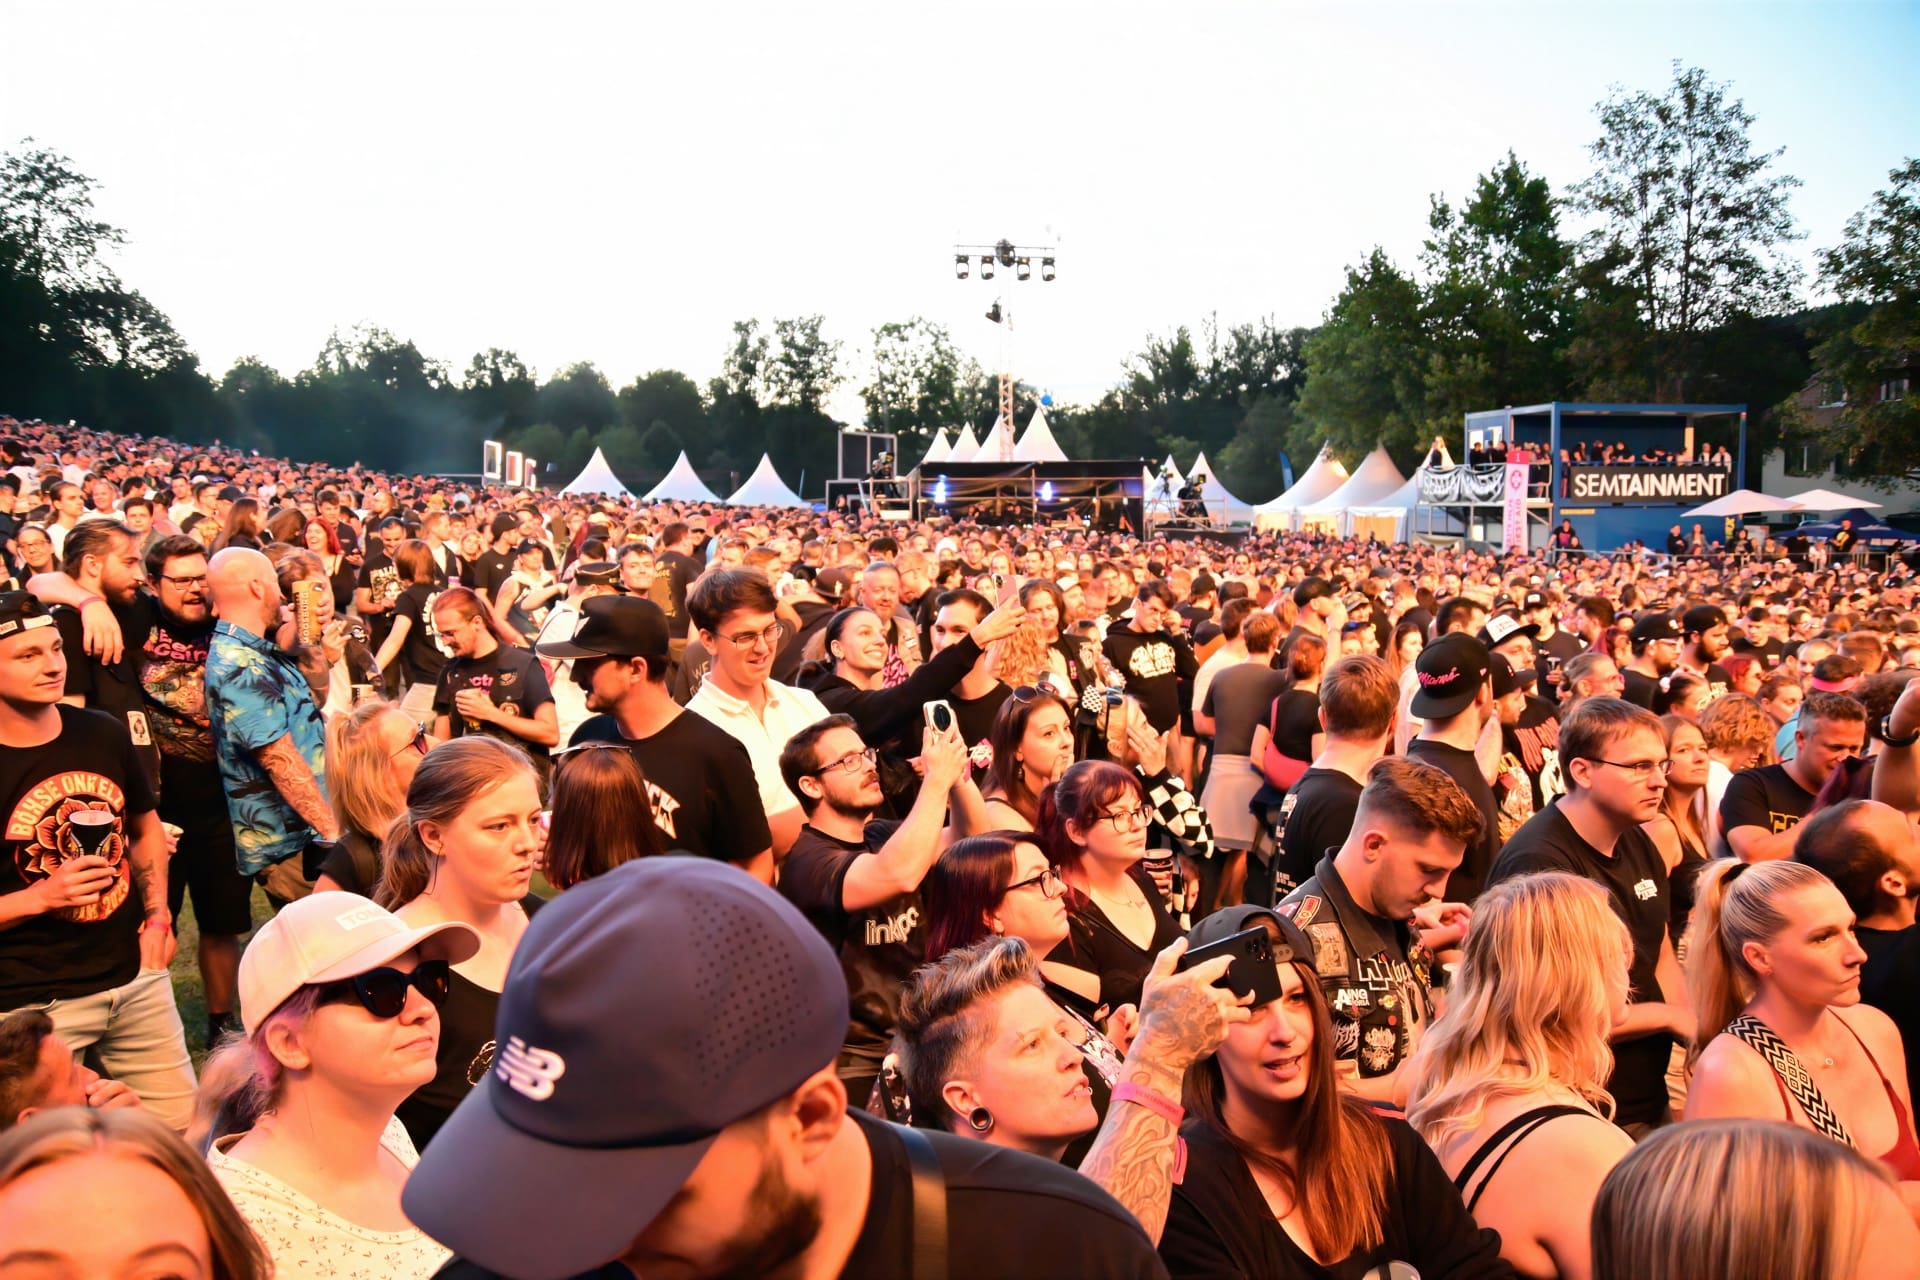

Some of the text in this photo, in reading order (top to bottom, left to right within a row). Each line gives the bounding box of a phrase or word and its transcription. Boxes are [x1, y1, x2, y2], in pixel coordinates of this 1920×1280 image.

[1574, 473, 1725, 497] SEMTAINMENT
[10, 773, 124, 836] BÖHSE ONKELZ
